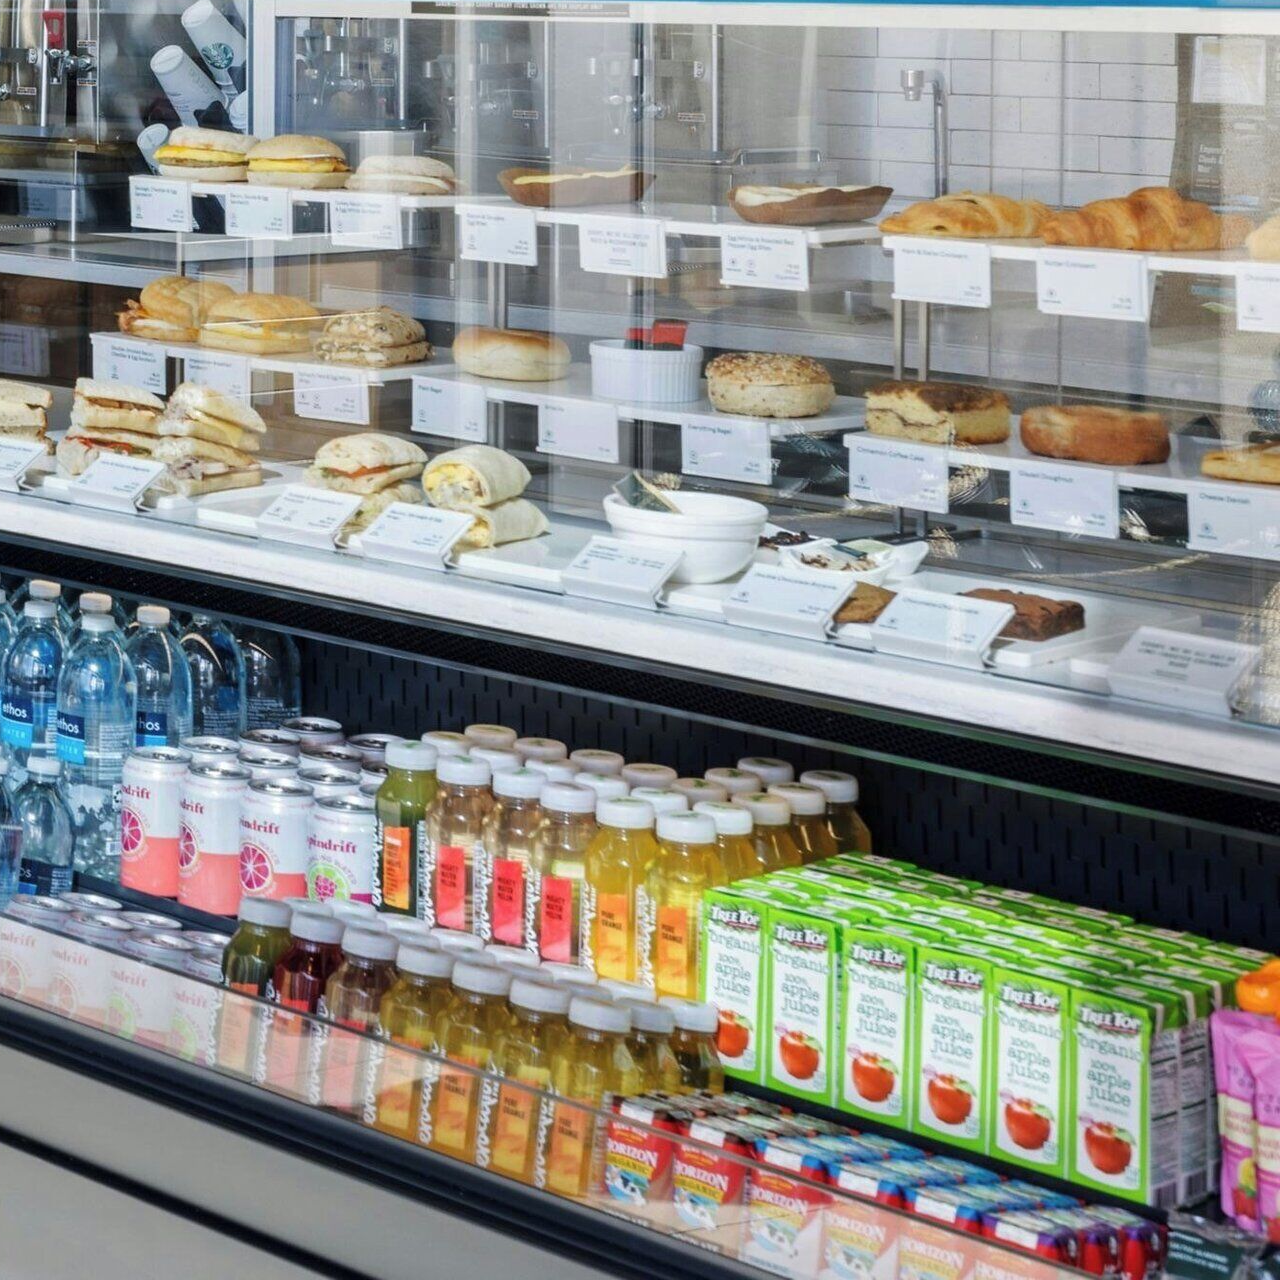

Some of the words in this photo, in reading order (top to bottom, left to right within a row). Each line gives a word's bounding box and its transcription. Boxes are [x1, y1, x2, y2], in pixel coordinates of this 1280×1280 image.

[715, 962, 751, 980] apple
[714, 975, 751, 996] juice
[1087, 1069, 1131, 1090] apple
[1087, 1084, 1131, 1107] juice
